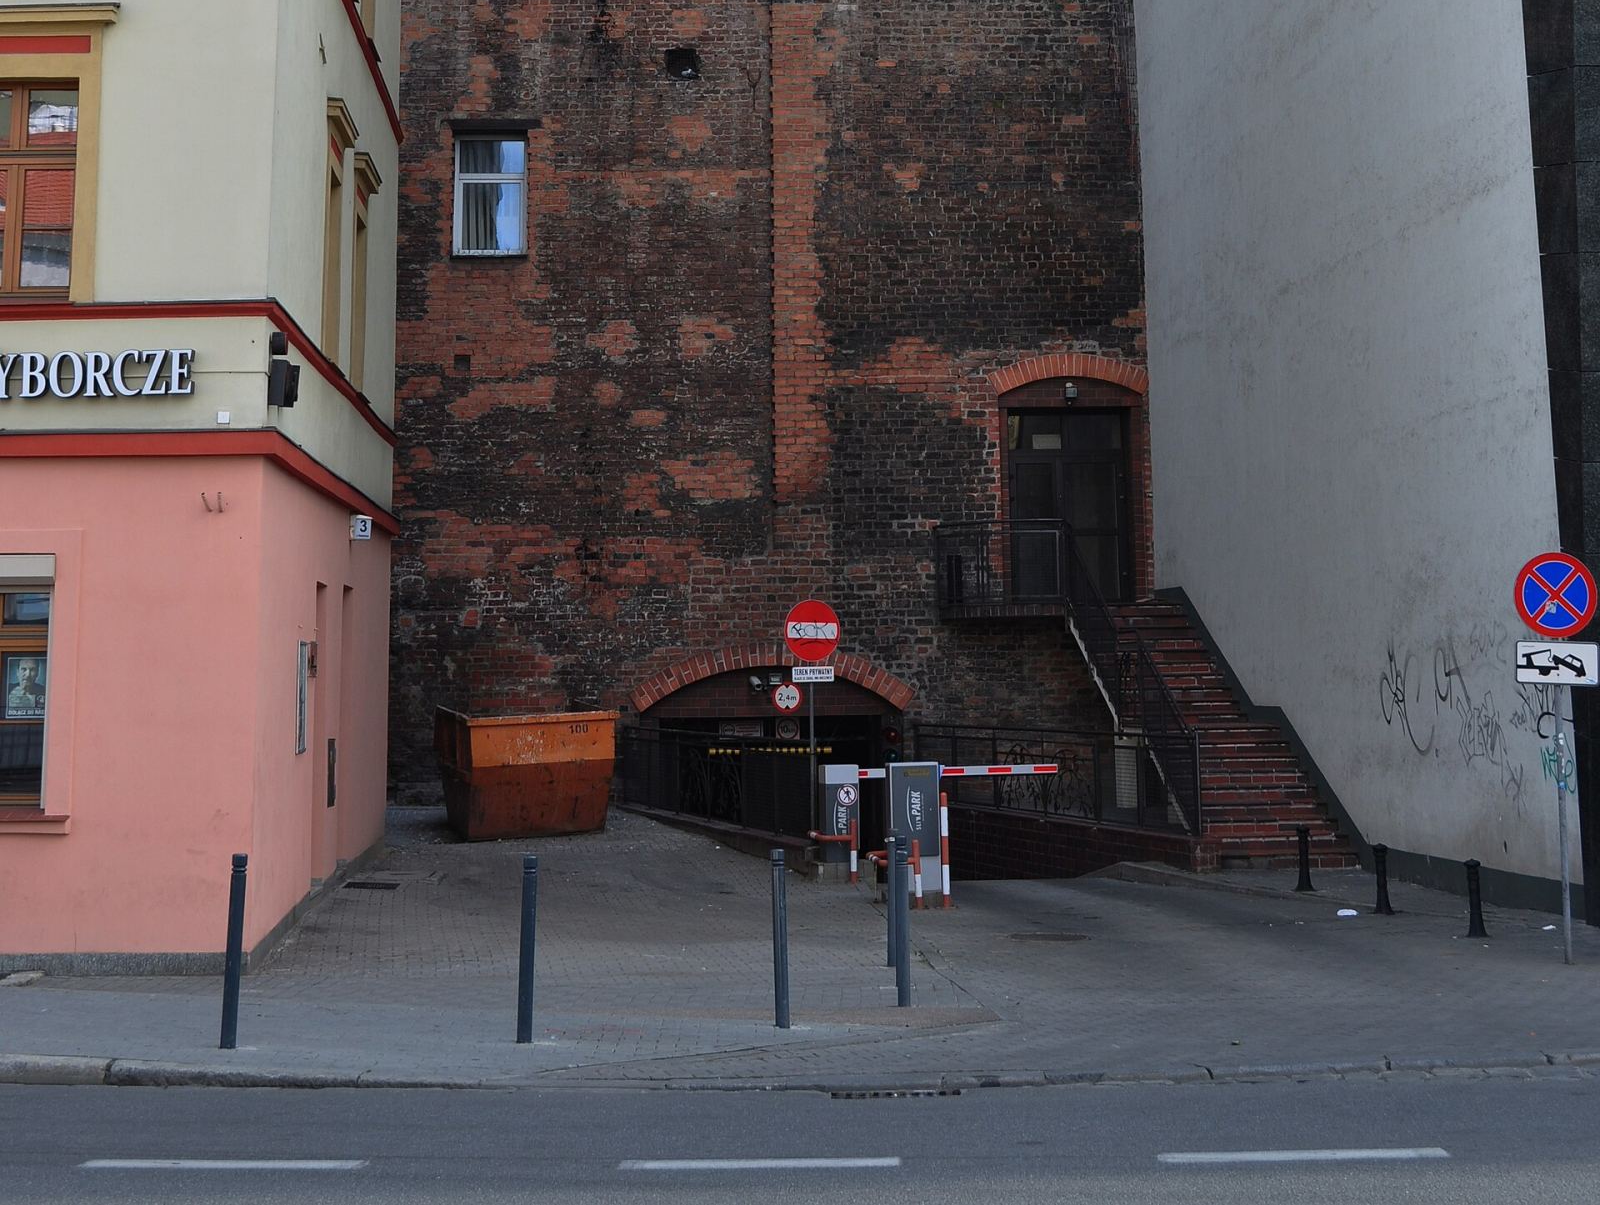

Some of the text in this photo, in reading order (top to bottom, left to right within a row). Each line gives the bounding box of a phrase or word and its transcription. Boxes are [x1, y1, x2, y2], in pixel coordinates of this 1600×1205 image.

[359, 520, 367, 533] 3
[794, 667, 833, 676] TEREN PRYWATNY
[568, 723, 589, 734] 100
[910, 790, 921, 816] PARK
[838, 805, 847, 829] PARK
